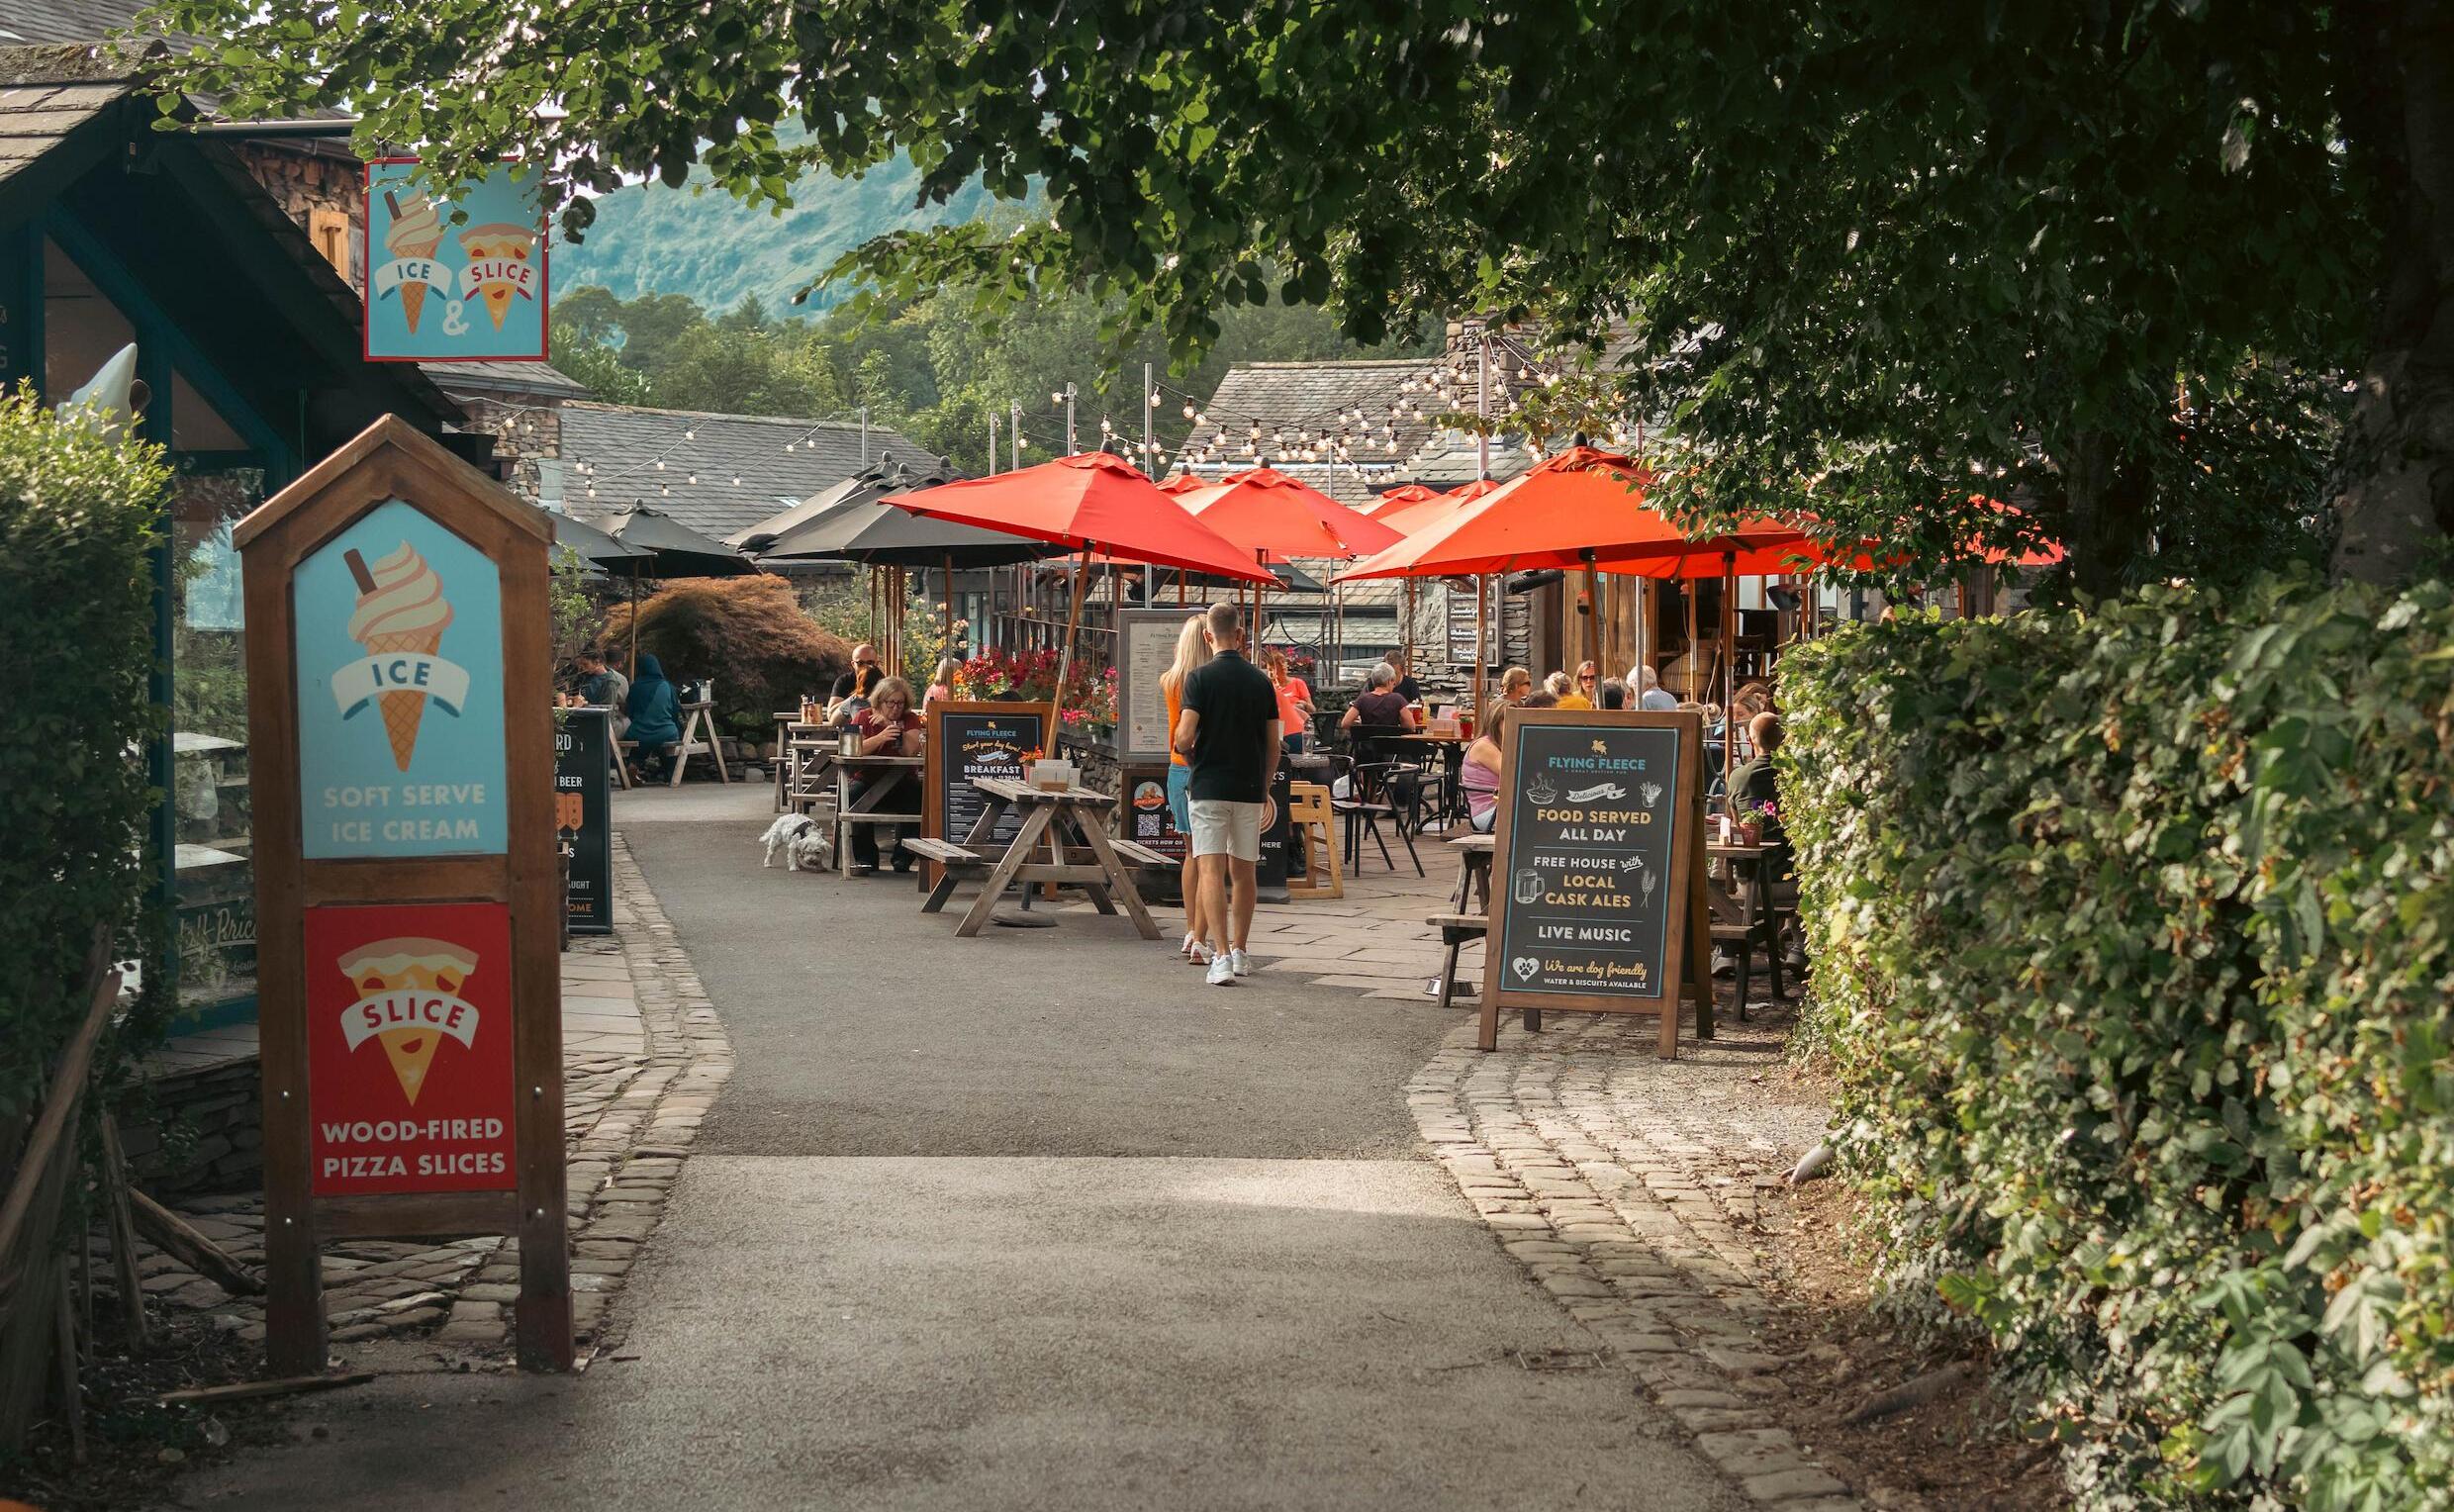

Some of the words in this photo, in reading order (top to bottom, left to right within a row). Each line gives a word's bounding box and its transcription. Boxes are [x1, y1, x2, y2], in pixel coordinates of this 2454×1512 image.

[398, 262, 431, 279] ICE
[471, 262, 531, 284] SLICE
[442, 300, 470, 336] &
[371, 659, 430, 687] ICE
[555, 733, 572, 750] RD
[964, 765, 1021, 774] BREAKFAST
[1549, 757, 1595, 769] FLYING
[1598, 759, 1647, 770] FLEECE
[559, 776, 583, 787] BEER
[324, 787, 391, 807] SOFT
[403, 784, 486, 806] SERVE
[1572, 789, 1604, 800] Delicious
[1537, 808, 1583, 822] FOOD
[1589, 810, 1652, 824] SERVED
[331, 822, 371, 842] ICE
[383, 819, 479, 841] CREAM
[1559, 827, 1588, 841] ALL
[1593, 829, 1627, 842] DAY
[1534, 856, 1565, 868] FREE
[1570, 857, 1617, 869] HOUSE
[1620, 856, 1644, 873] with
[569, 881, 590, 890] UGHT
[1563, 875, 1616, 889] LOCAL
[1545, 892, 1588, 906] CASK
[1592, 894, 1632, 908] ALES
[217, 907, 257, 944] Pric
[1538, 925, 1573, 939] LIVE
[1578, 927, 1632, 942] MUSIC
[1545, 960, 1564, 972] We
[1566, 964, 1584, 973] are
[1586, 961, 1603, 980] dog
[1606, 960, 1648, 981] friendly
[1575, 979, 1607, 988] BISCUITS
[1609, 981, 1647, 990] AVAILABLE
[362, 997, 465, 1029] SLICE
[321, 1118, 504, 1143] WOOD-FIRED
[324, 1156, 408, 1178] PIZZA
[418, 1152, 506, 1176] SLICES
